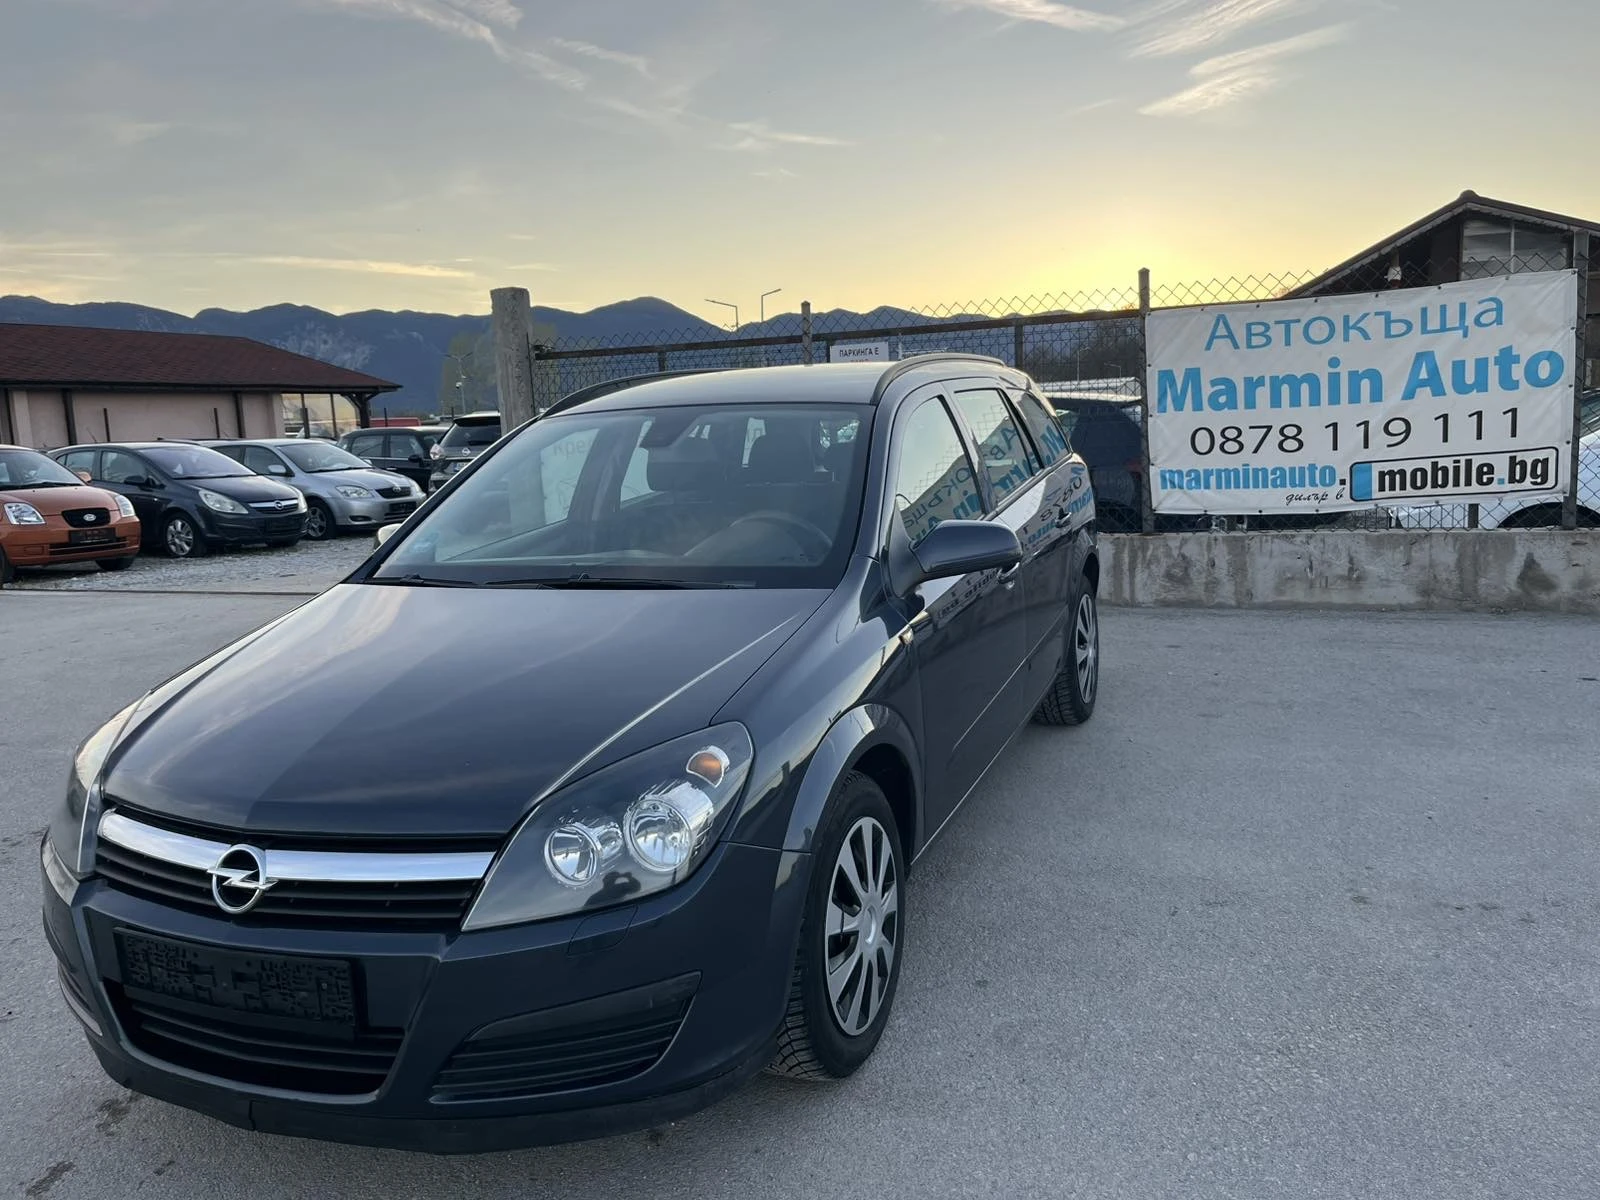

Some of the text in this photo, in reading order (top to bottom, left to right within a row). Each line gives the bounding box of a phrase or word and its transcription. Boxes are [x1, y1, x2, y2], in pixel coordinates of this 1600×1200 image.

[1204, 296, 1504, 351] Автокъща
[839, 348, 873, 357] ПАРКИНГА
[1156, 344, 1565, 413] Marmin Auto
[1189, 407, 1518, 455] 0878 119 111
[1377, 455, 1550, 492] mobile.bg
